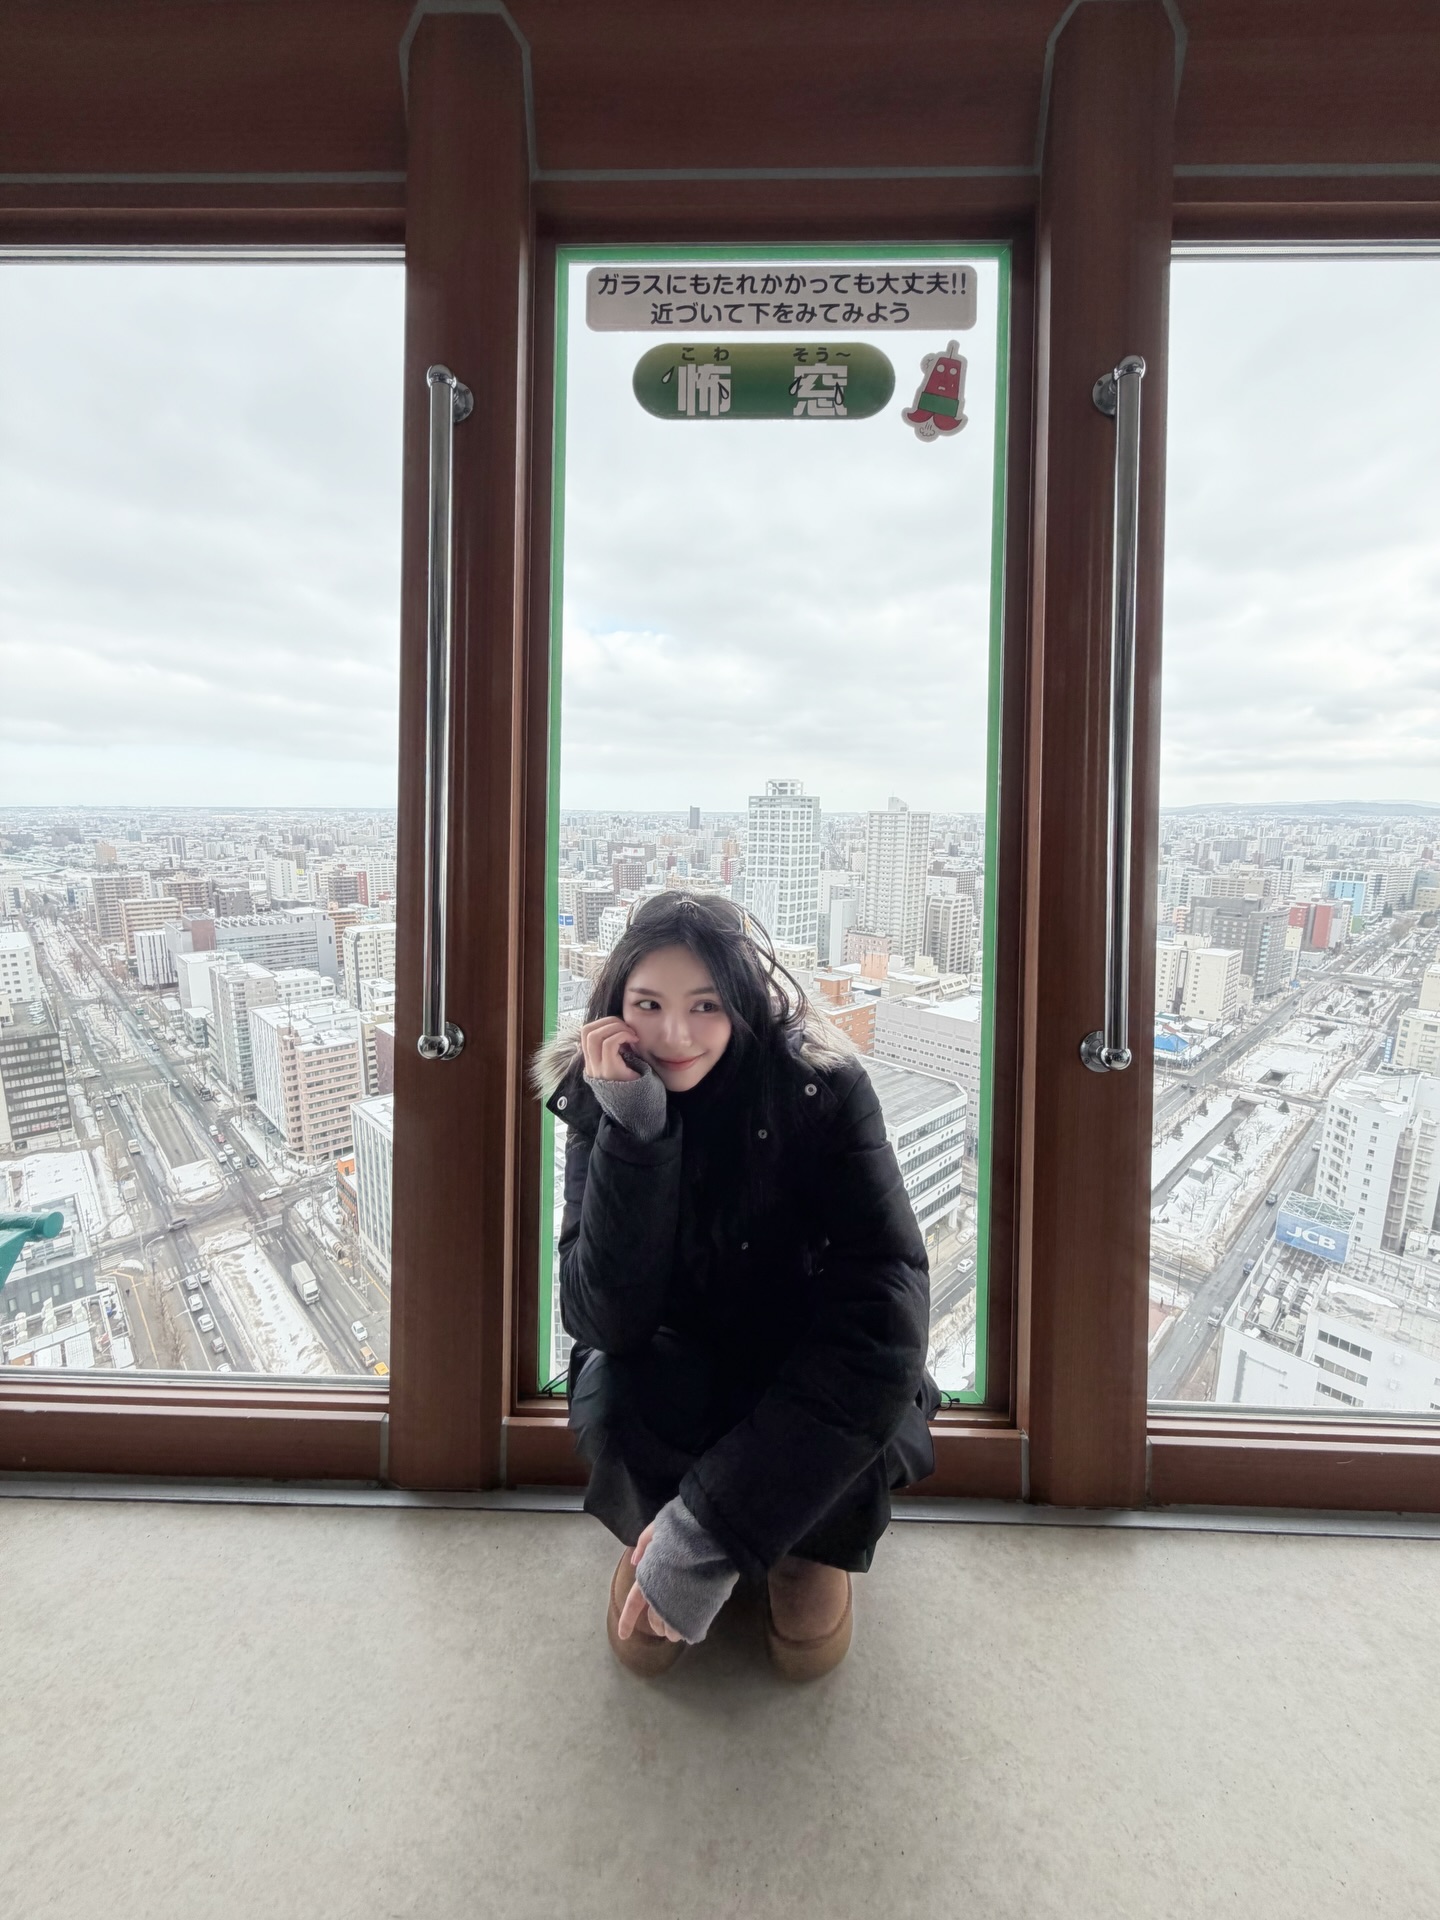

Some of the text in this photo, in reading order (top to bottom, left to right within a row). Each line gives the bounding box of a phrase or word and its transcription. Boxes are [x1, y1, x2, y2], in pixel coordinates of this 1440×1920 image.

[597, 271, 967, 296] ガラスにもたれかかっても大丈夫!!
[650, 301, 911, 325] 近づいて下をみてみよう
[1286, 1226, 1336, 1250] JCB
